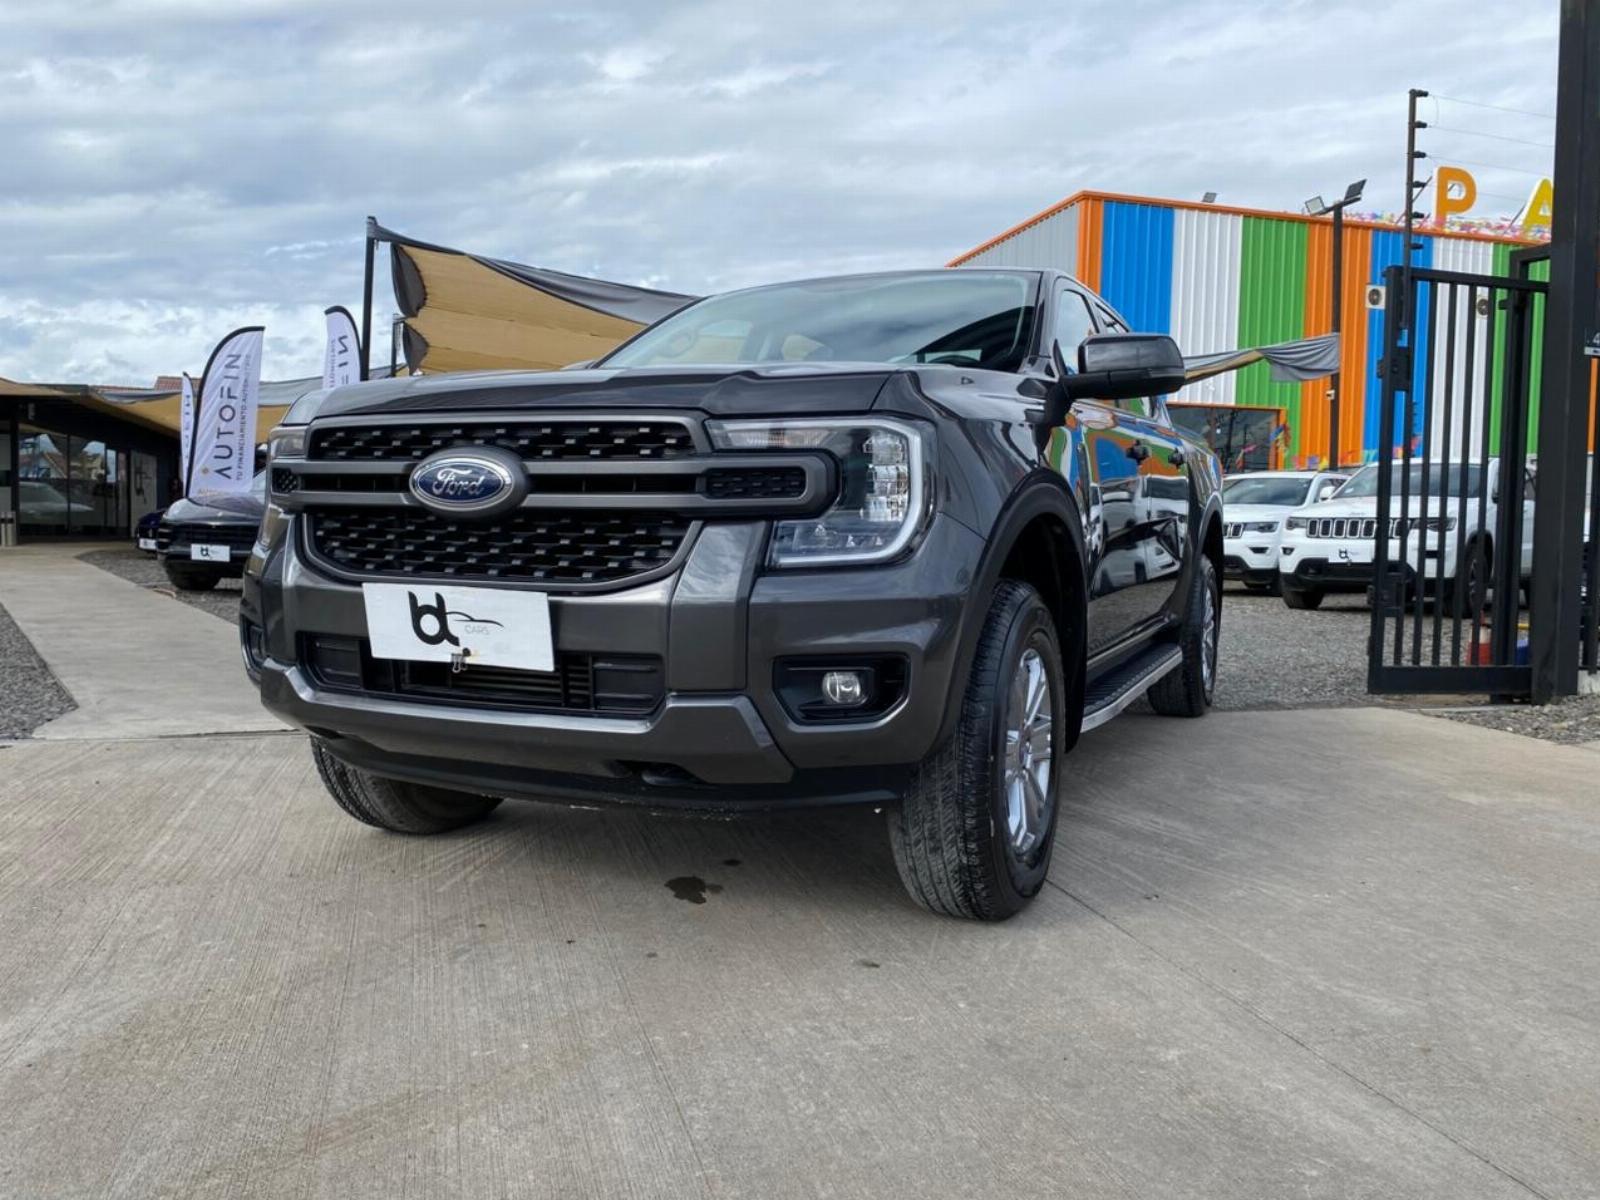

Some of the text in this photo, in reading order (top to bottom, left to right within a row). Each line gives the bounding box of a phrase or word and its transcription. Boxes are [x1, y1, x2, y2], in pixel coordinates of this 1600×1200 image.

[213, 353, 242, 480] AUTOFIN
[432, 468, 485, 495] Ford
[465, 624, 490, 636] CARS
